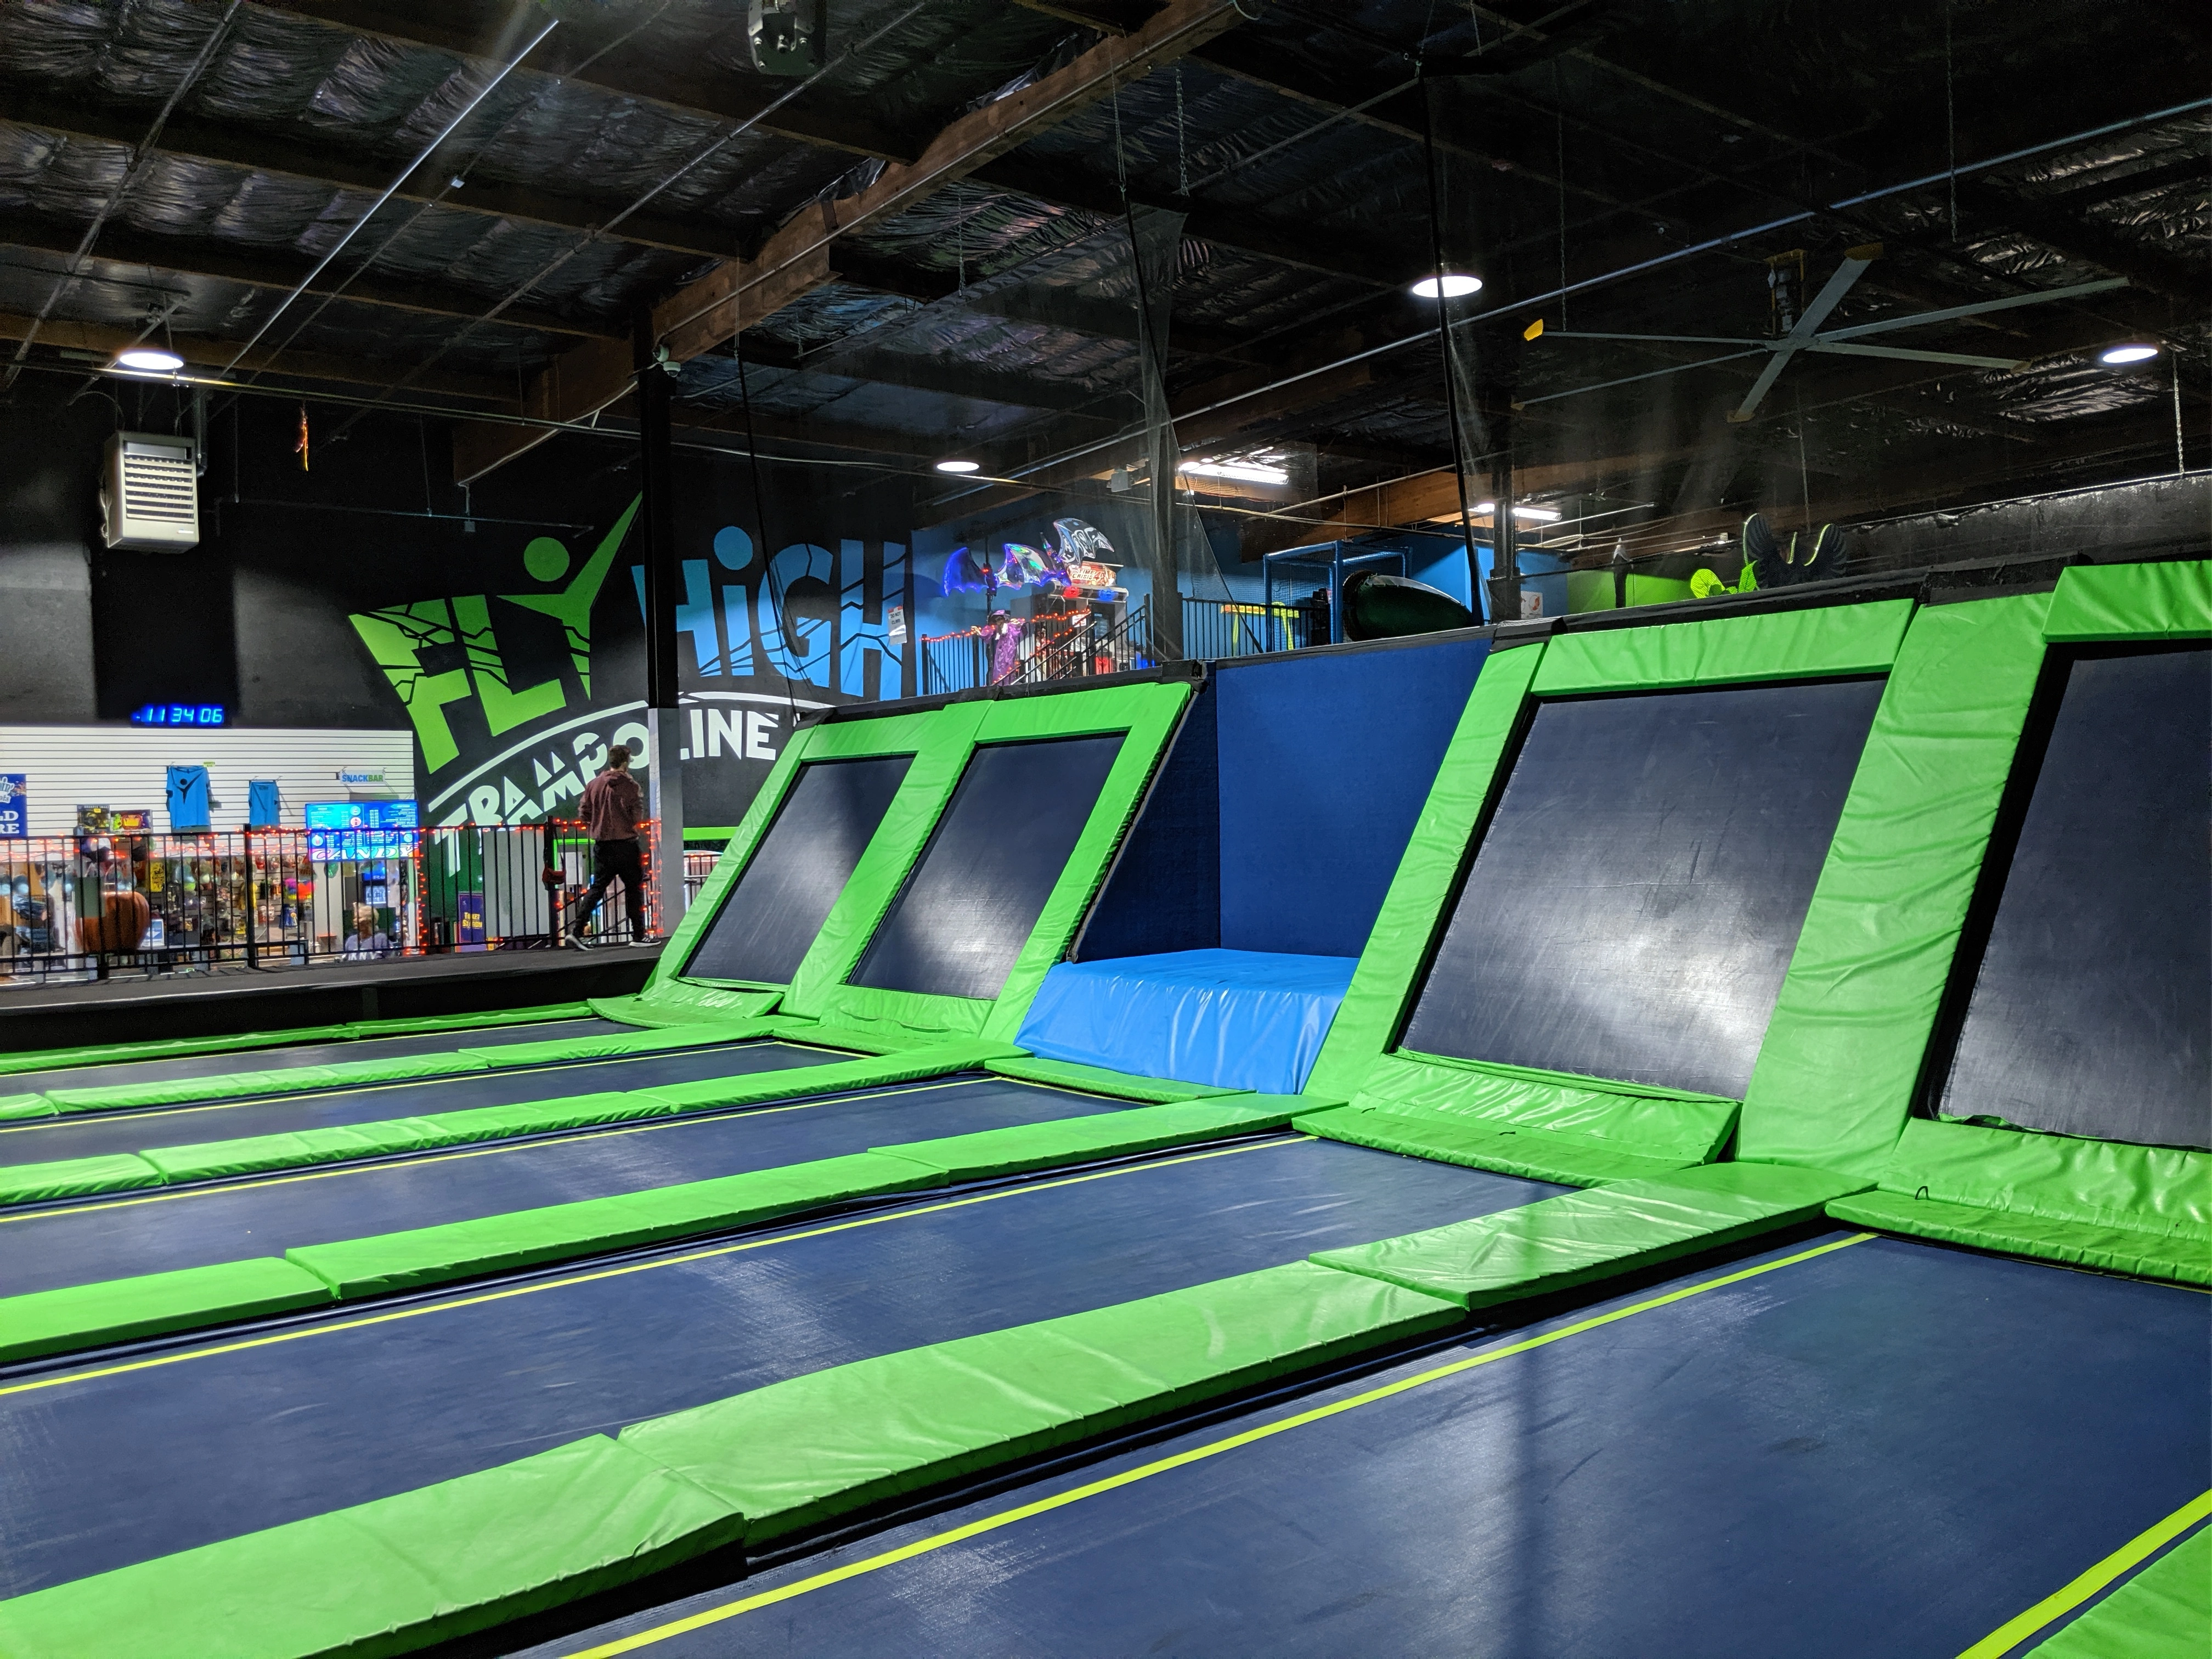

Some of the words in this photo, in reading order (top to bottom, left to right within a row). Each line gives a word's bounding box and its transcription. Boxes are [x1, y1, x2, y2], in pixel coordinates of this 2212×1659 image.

[348, 490, 642, 774] FLY
[312, 847, 414, 861] CANDY
[435, 708, 779, 877] TRAMPOINE
